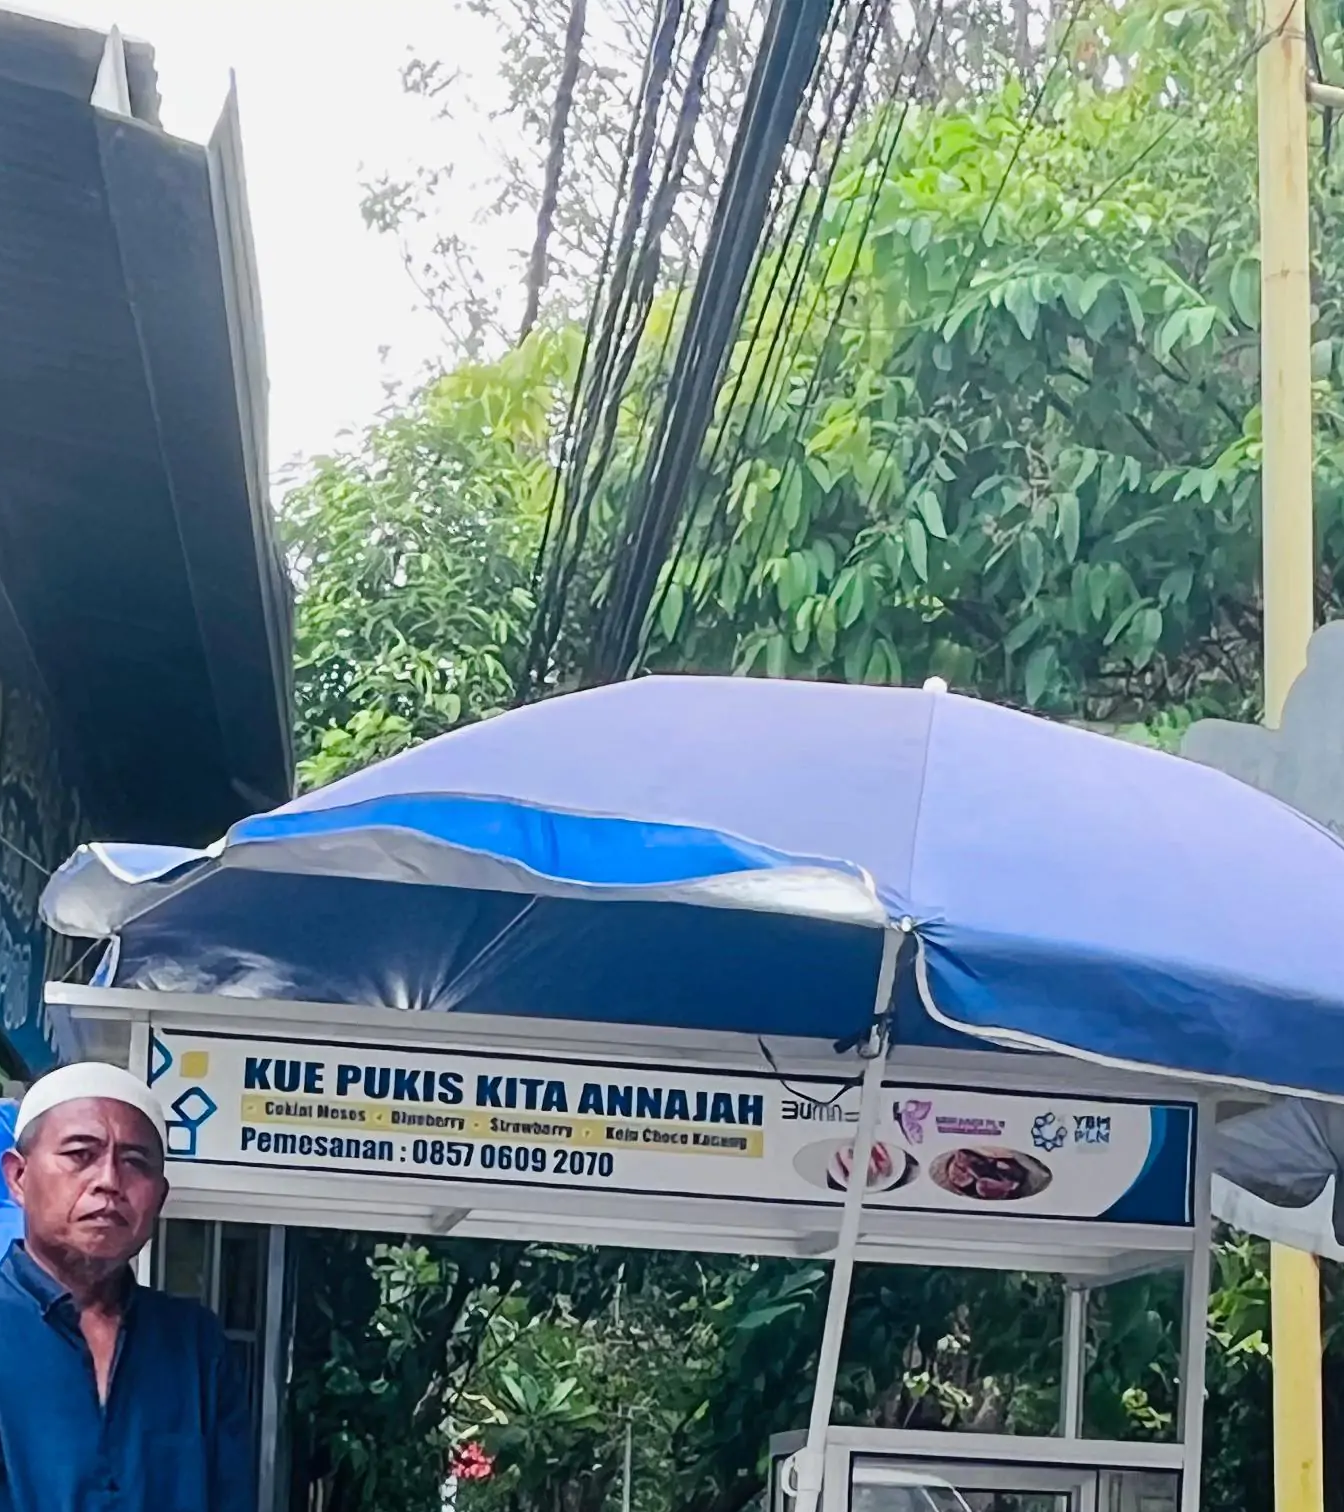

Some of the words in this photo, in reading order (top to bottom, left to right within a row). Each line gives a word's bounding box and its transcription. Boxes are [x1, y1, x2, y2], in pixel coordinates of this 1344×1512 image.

[245, 1057, 324, 1095] KUE
[337, 1064, 463, 1105] PUKIS
[476, 1074, 568, 1114] KITA
[577, 1083, 763, 1126] ANNAJAH
[241, 1127, 393, 1161] Pemesanan
[413, 1139, 474, 1167] 0857
[481, 1144, 547, 1173] 0609
[553, 1149, 613, 1177] 2070
